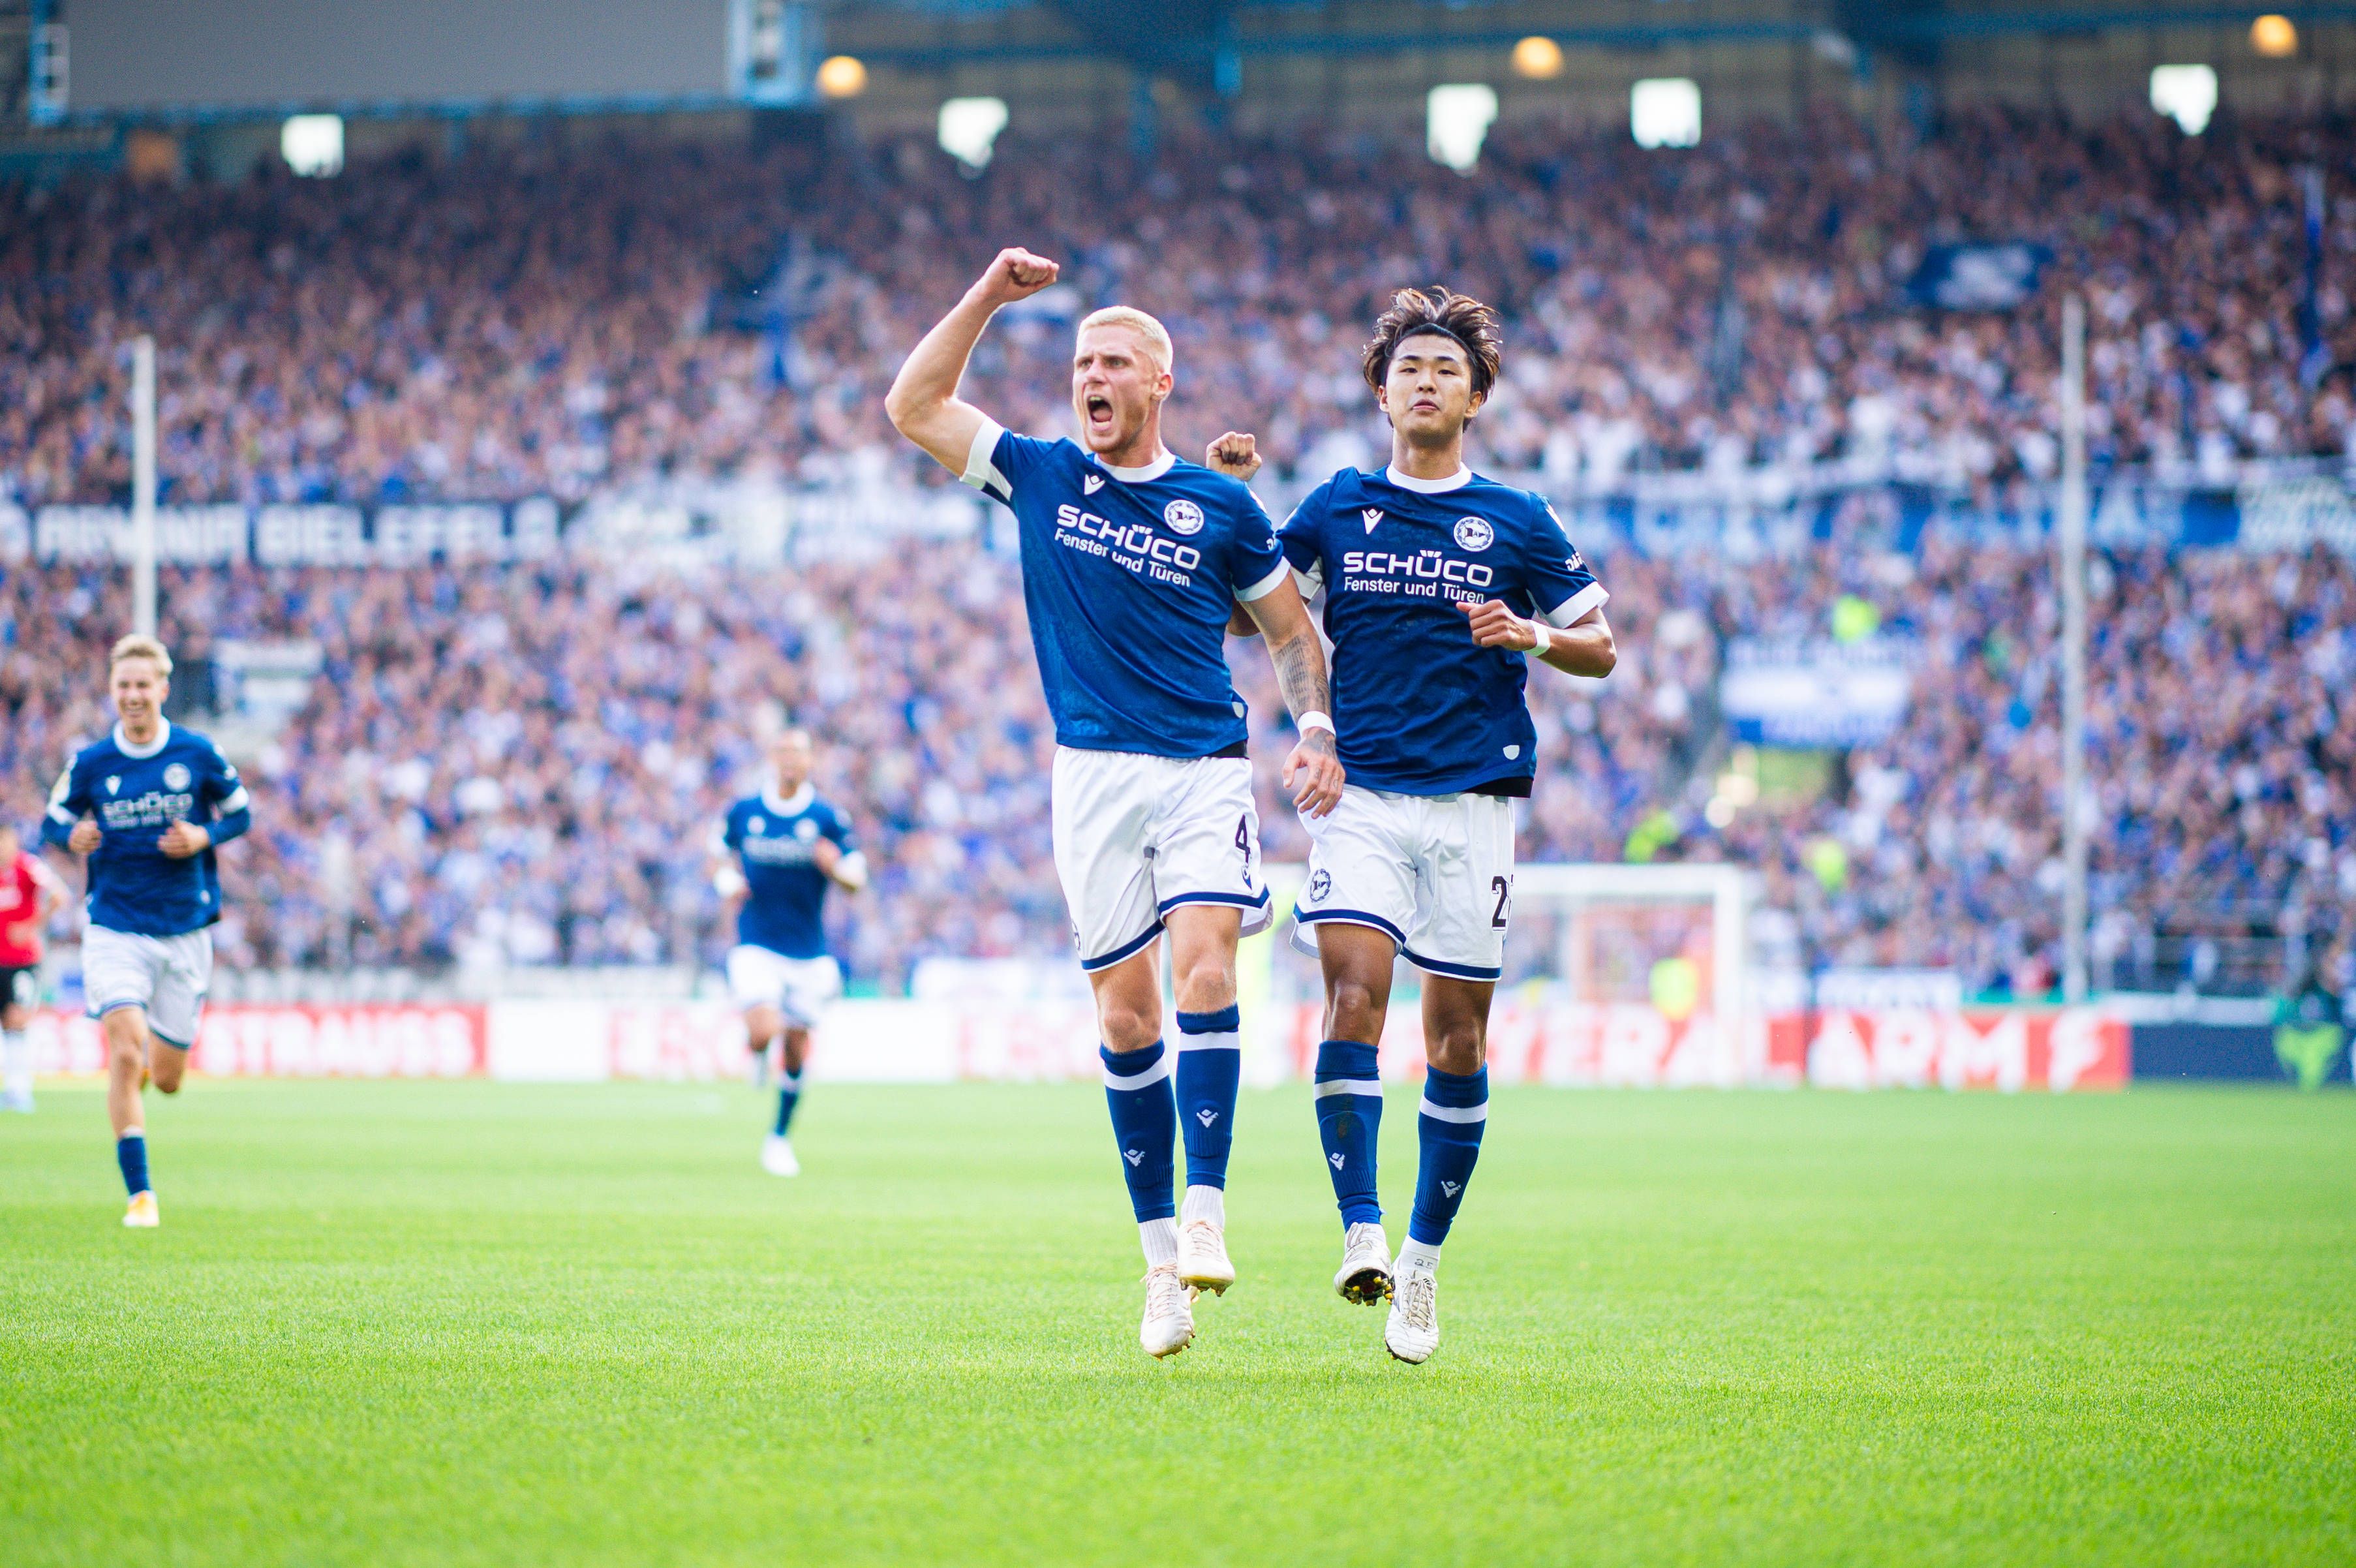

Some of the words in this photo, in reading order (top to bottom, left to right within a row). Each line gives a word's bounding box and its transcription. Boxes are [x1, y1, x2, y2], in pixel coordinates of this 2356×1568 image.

[1054, 527, 1109, 557] Fenster
[1111, 551, 1144, 573] und
[1148, 561, 1190, 587] Türen
[1056, 504, 1201, 570] SCHÜCO
[1343, 549, 1493, 587] SCHÜCO
[1344, 576, 1401, 593] Fenster
[1405, 581, 1437, 597] und
[1441, 583, 1484, 604] Türen
[1235, 814, 1251, 865] 4
[1491, 874, 1514, 931] 2
